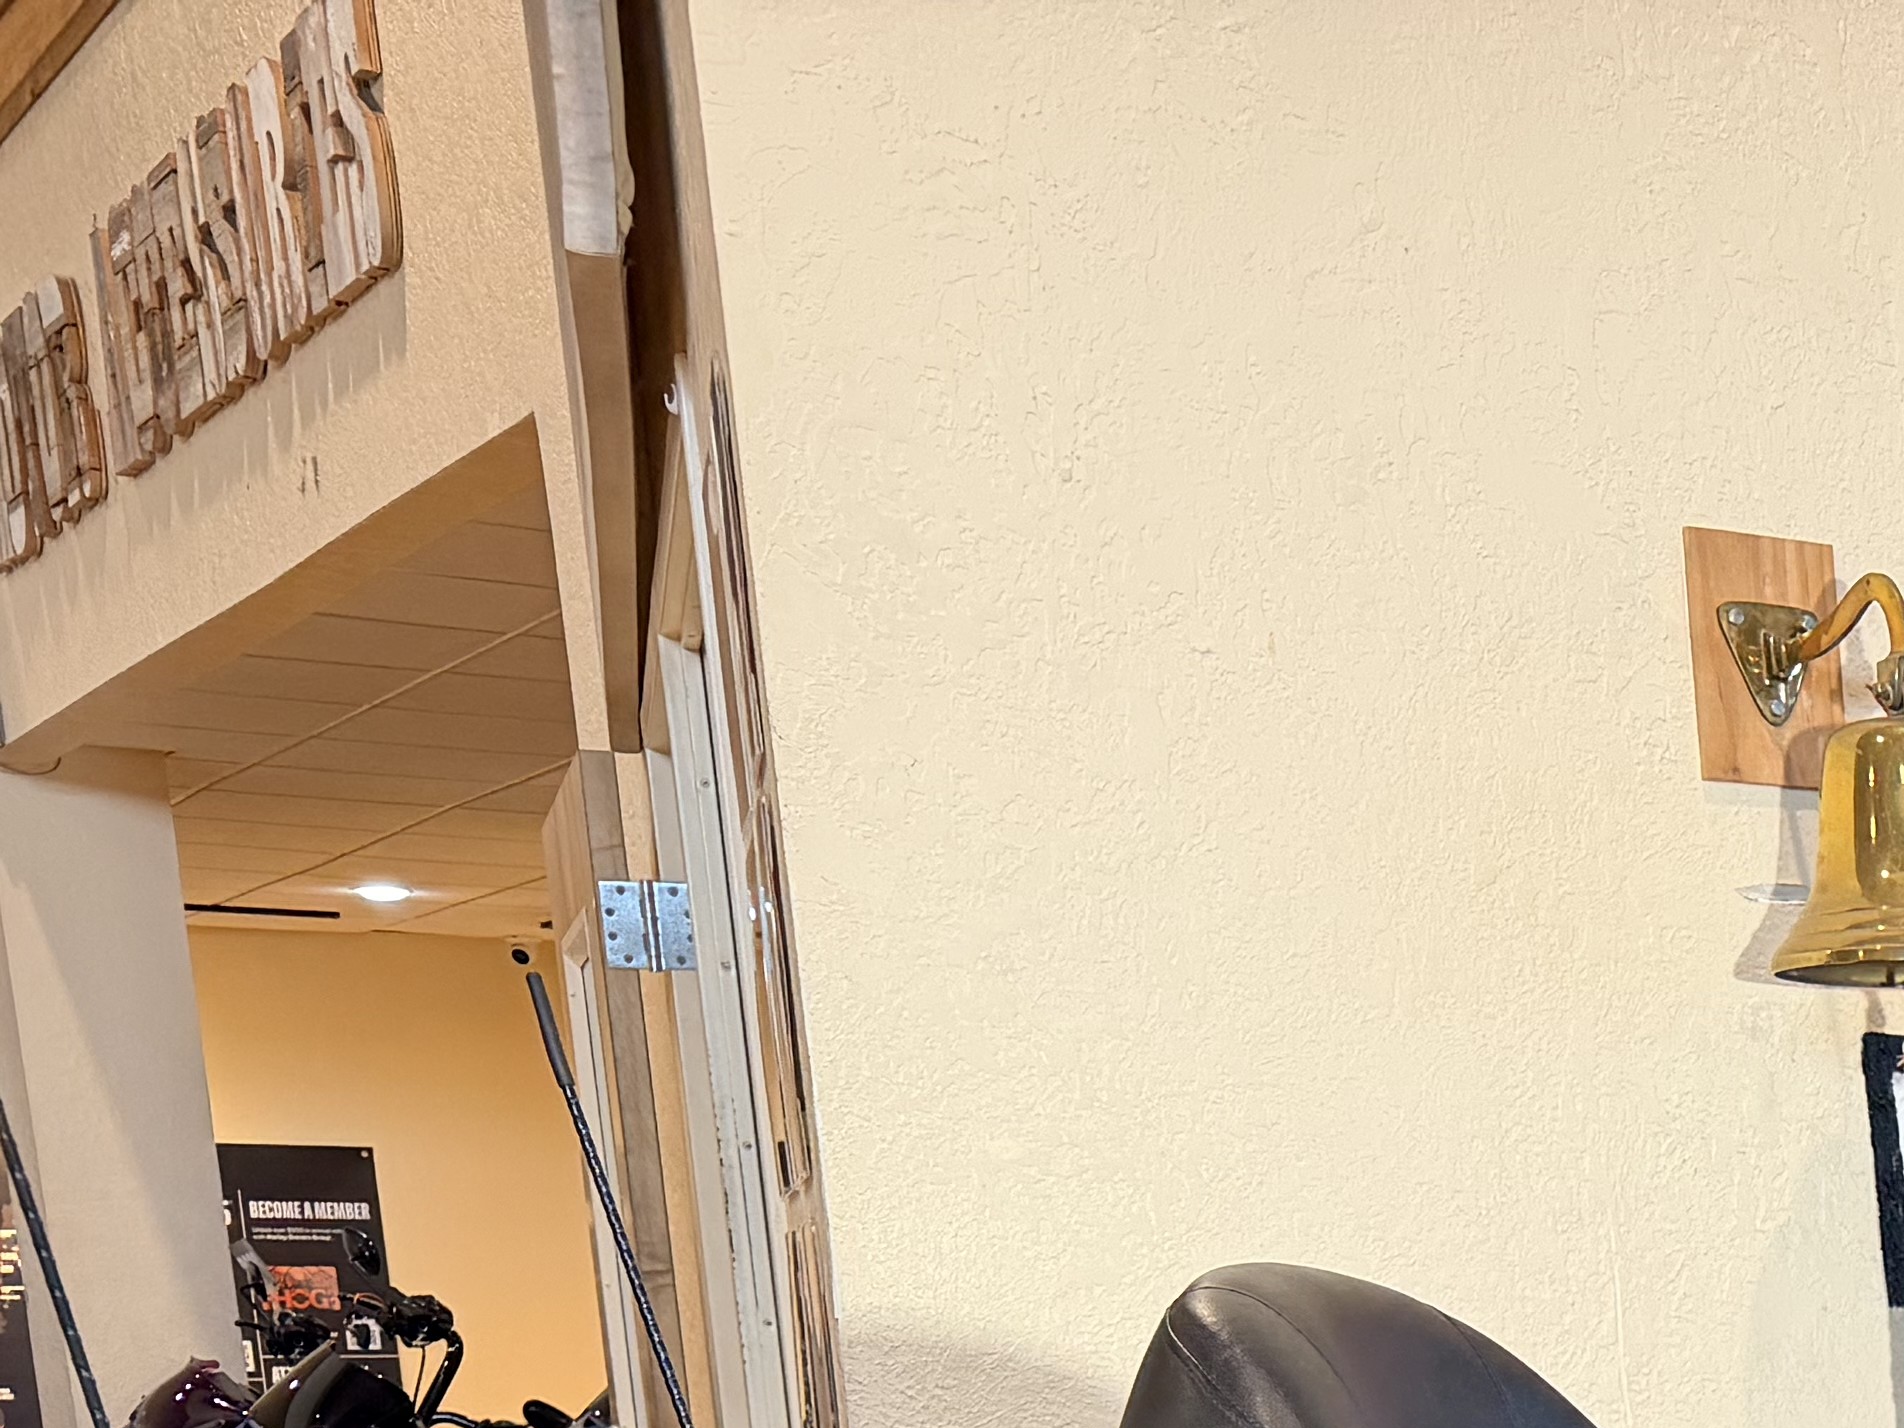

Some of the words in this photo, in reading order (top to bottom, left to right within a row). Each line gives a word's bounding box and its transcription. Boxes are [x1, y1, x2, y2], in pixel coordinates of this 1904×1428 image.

[249, 1200, 302, 1219] BECOME
[303, 1201, 313, 1219] A
[314, 1201, 371, 1220] MEMBER
